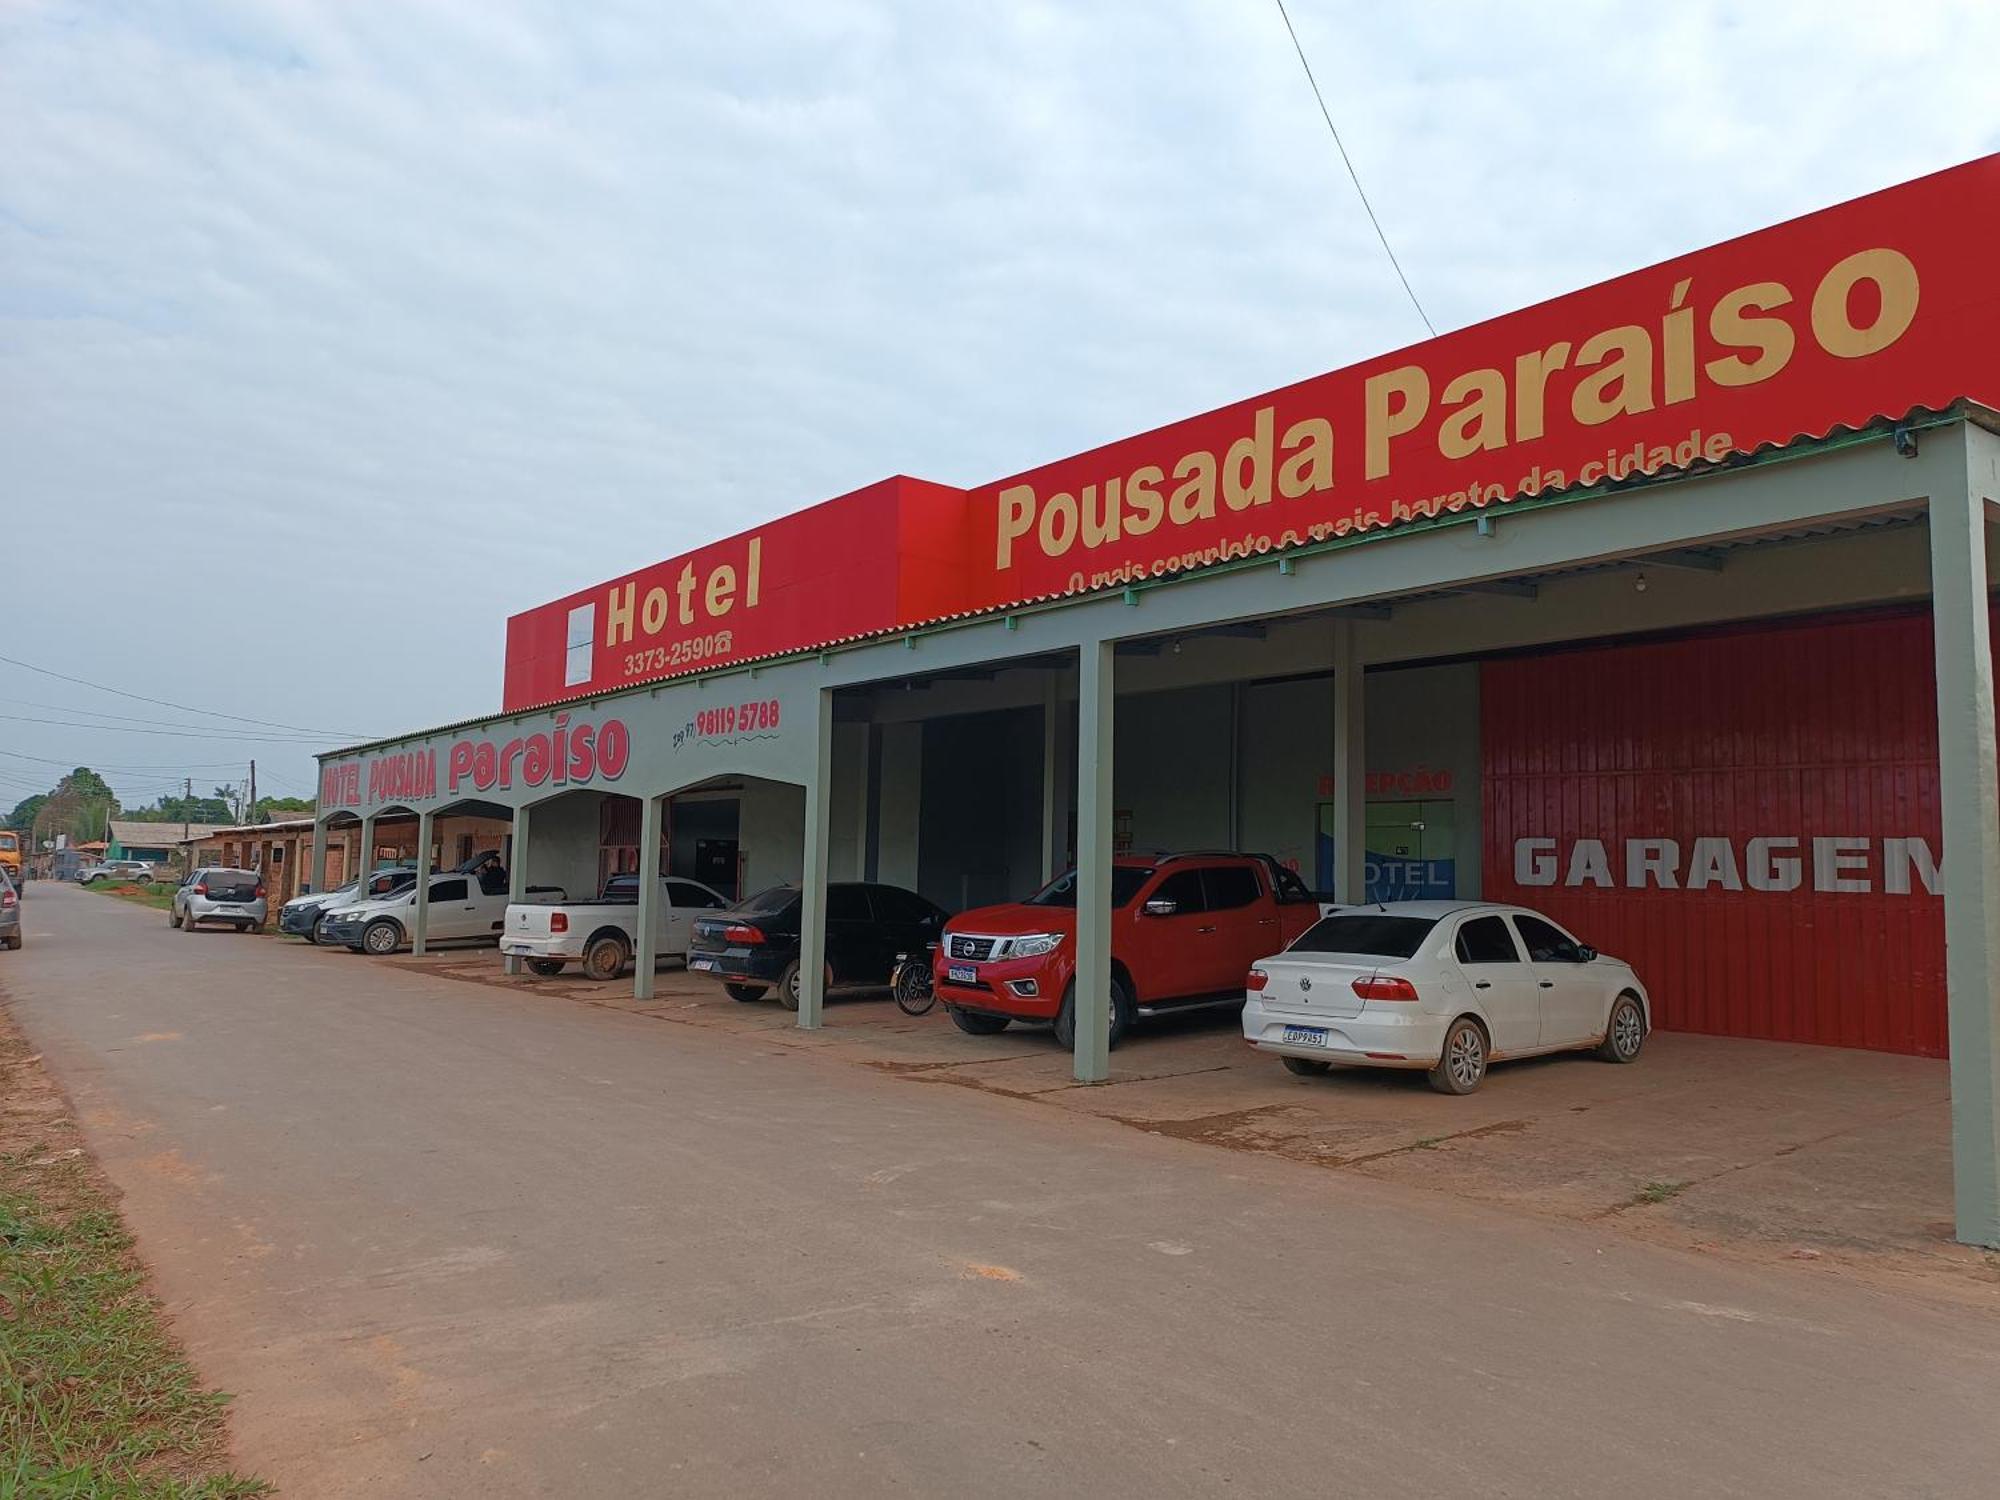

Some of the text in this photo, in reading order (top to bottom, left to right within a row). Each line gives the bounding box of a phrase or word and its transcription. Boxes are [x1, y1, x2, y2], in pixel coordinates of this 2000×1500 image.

[997, 248, 1920, 570] Pousada Paraíso
[1091, 560, 1146, 590] mais
[1517, 466, 1567, 497] da
[1579, 429, 1733, 485] cidade
[606, 536, 761, 648] Hotel
[624, 634, 714, 677] 3373-2590
[697, 706, 736, 737] 98119
[738, 699, 780, 732] 5788
[322, 763, 361, 809] HOTEL
[368, 746, 437, 806] POUSADA
[1333, 861, 1450, 886] OTEL
